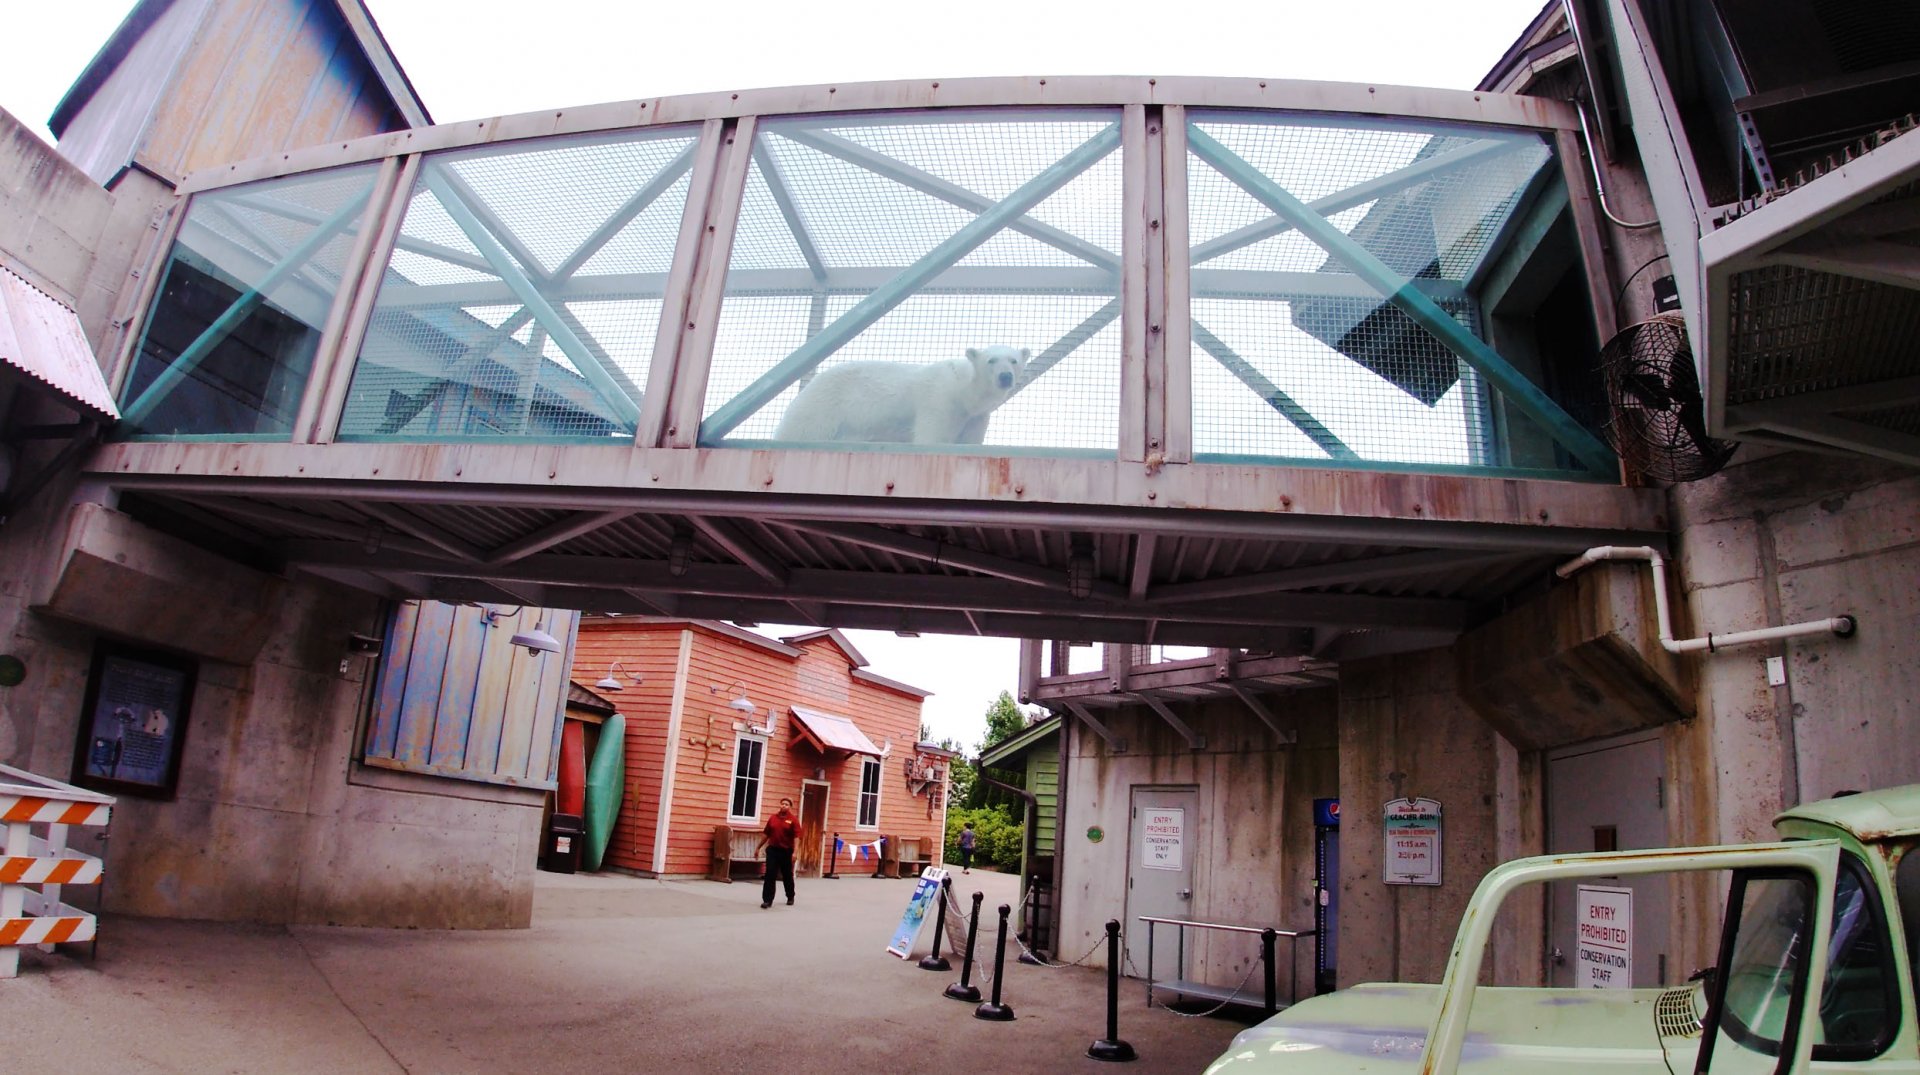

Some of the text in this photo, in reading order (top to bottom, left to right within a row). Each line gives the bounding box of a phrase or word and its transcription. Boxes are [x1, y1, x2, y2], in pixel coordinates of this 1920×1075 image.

[1146, 825, 1180, 833] PROHIBITED
[1590, 905, 1616, 920] ENTRY
[1581, 923, 1627, 944] PROHIBITED
[1580, 948, 1627, 969] CONSERVATION
[1592, 967, 1612, 982] STAFF
